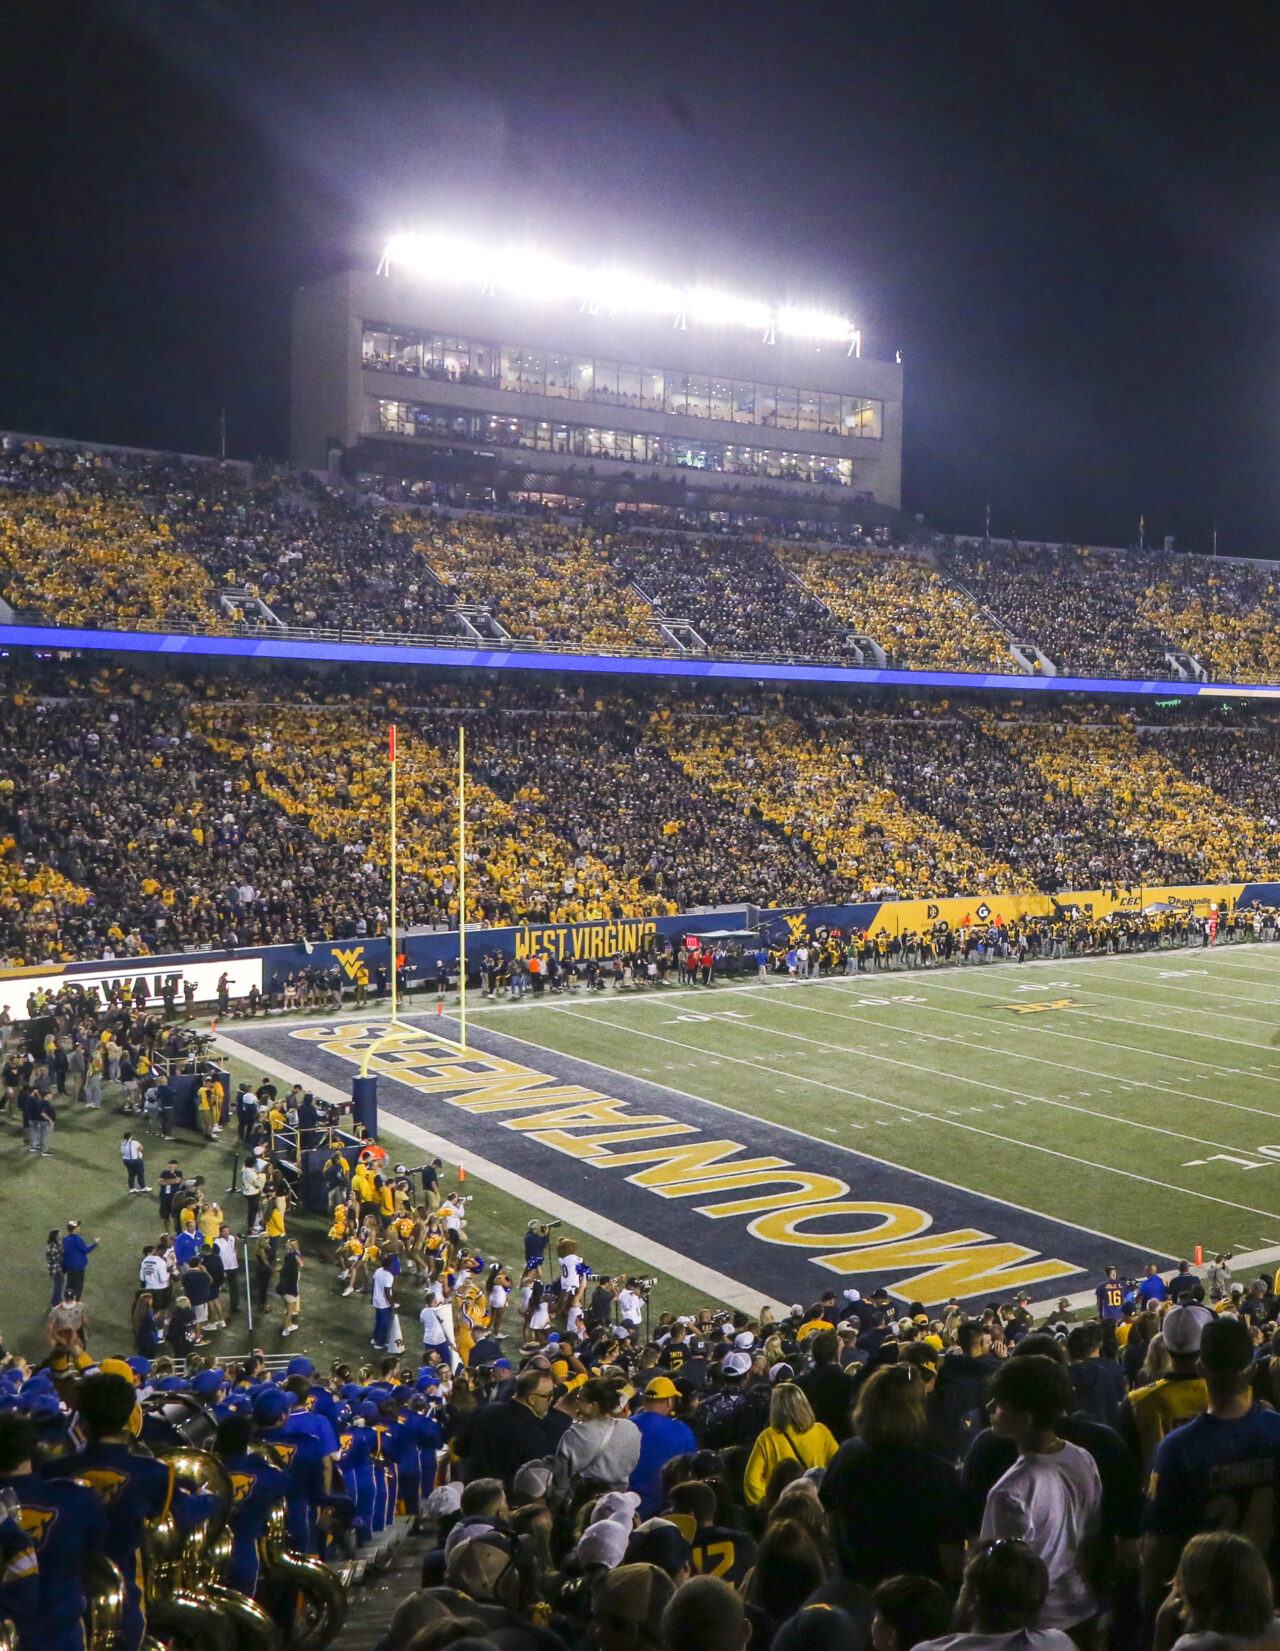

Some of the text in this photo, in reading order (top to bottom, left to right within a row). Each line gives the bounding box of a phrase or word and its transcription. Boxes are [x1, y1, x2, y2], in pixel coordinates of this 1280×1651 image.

[1176, 898, 1211, 906] Panhandle
[515, 920, 658, 962] WEST VIRGINIA
[287, 1022, 1089, 1307] MOUNTAINEERS
[1107, 1290, 1122, 1307] 16
